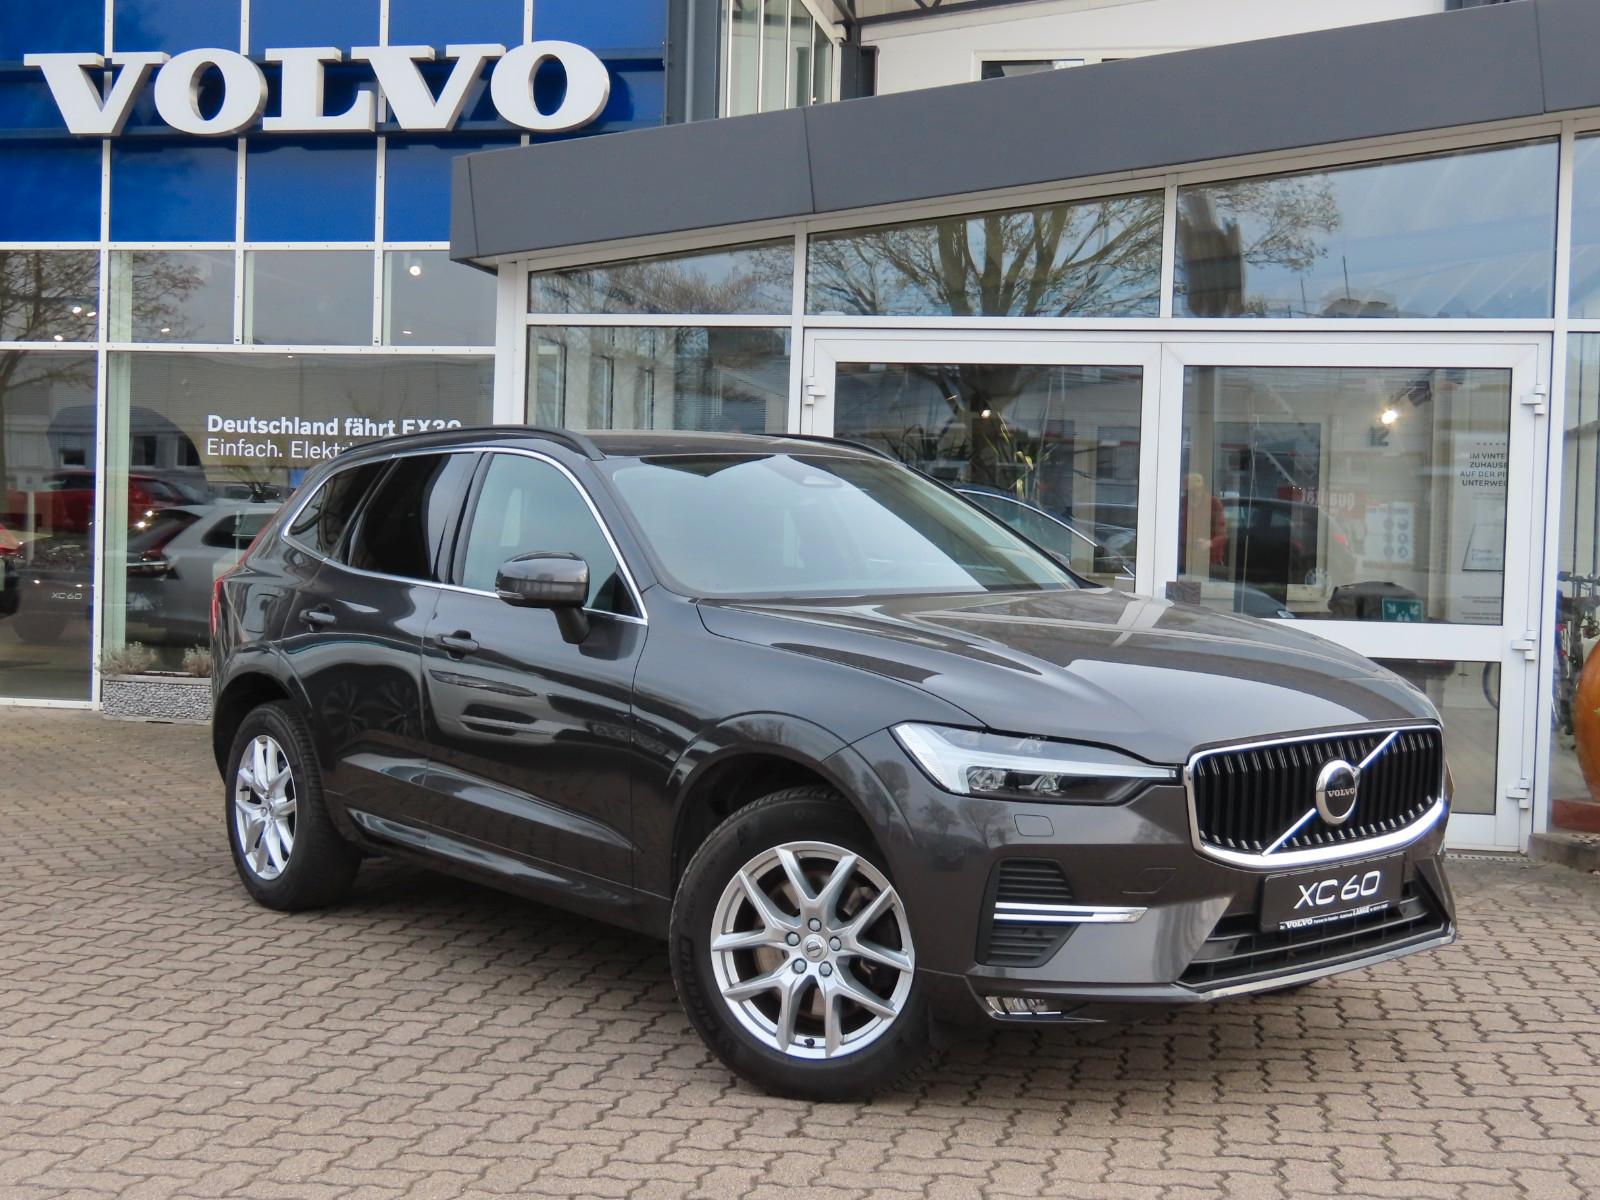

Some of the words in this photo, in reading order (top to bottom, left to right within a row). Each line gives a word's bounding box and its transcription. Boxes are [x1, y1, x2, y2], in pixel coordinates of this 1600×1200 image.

[24, 40, 610, 135] VOLVO
[207, 414, 338, 436] Deutschland
[344, 417, 397, 437] fährt
[206, 438, 283, 457] Einfach.
[291, 440, 353, 459] Elekt
[1327, 787, 1355, 798] VOLVO
[1286, 918, 1313, 929] VOLVO
